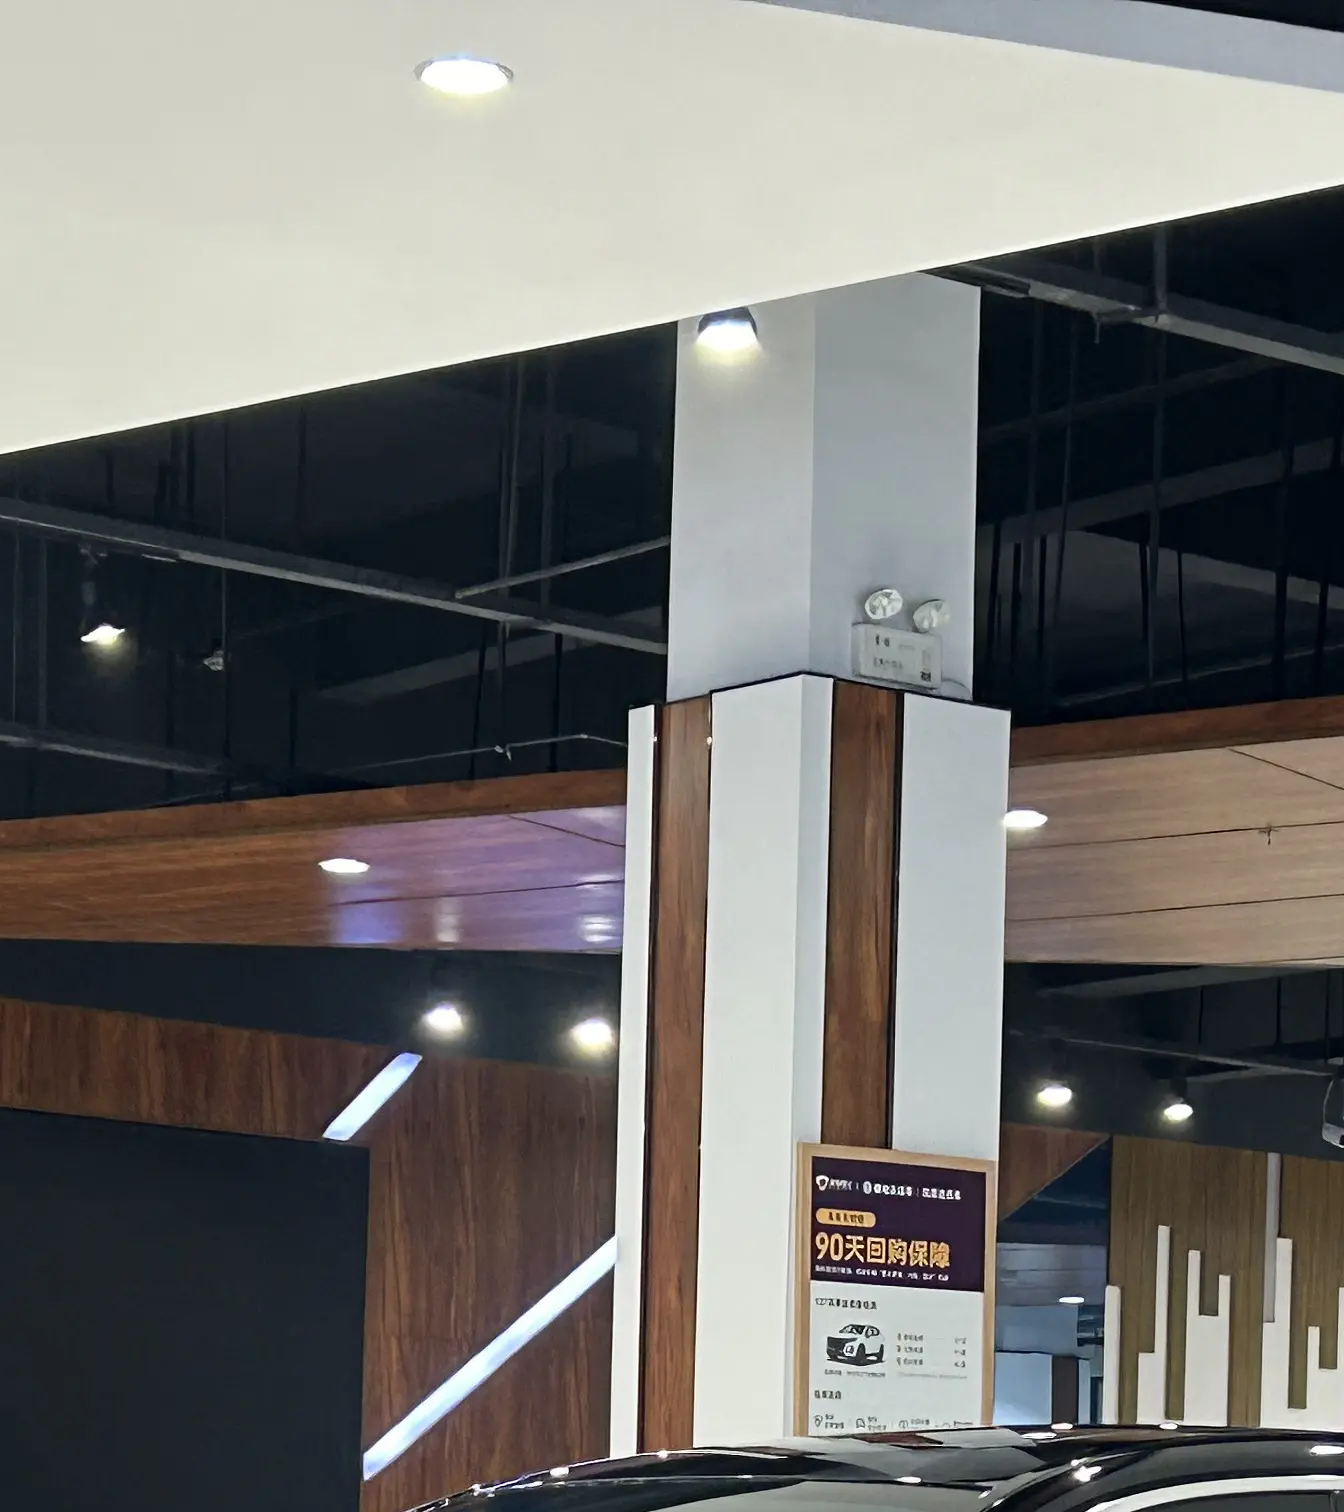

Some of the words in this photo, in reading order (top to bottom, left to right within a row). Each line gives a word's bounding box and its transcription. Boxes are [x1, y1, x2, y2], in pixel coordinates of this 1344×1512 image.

[815, 1231, 950, 1269] 90天回购保障
